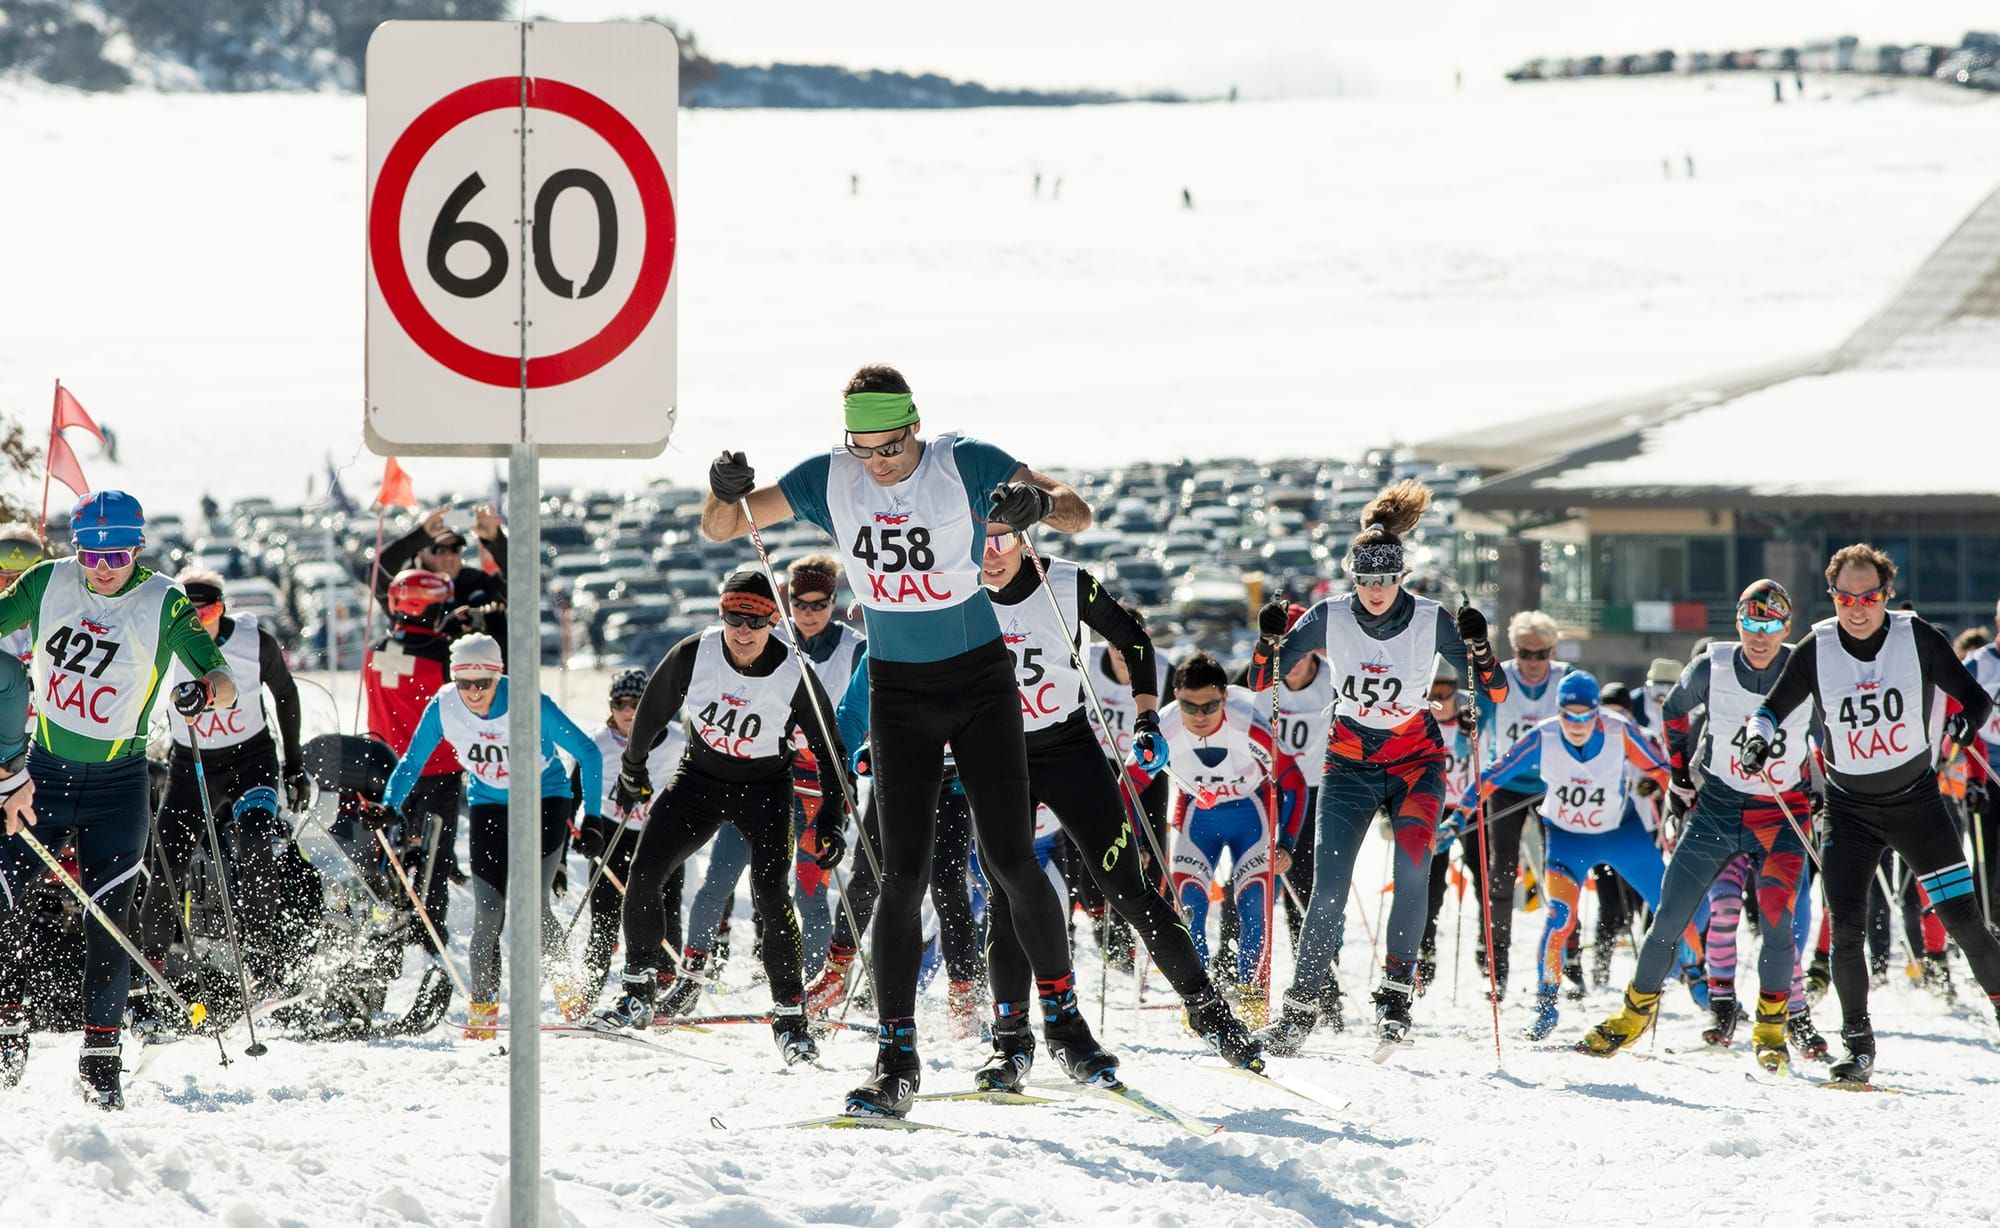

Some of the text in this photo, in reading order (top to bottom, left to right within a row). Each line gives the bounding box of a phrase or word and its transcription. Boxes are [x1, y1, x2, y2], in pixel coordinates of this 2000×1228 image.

[427, 168, 619, 299] 60
[852, 526, 935, 573] 458
[867, 572, 952, 603] KAC
[46, 625, 120, 679] 427
[46, 670, 118, 724] KAC
[1341, 674, 1402, 708] 452
[1839, 687, 1904, 730] 450
[698, 701, 761, 738] 440
[700, 724, 754, 759] KAC
[1730, 725, 1787, 759] 48
[1847, 722, 1909, 760] KAC
[1555, 785, 1606, 808] 404
[1558, 807, 1604, 828] KAC
